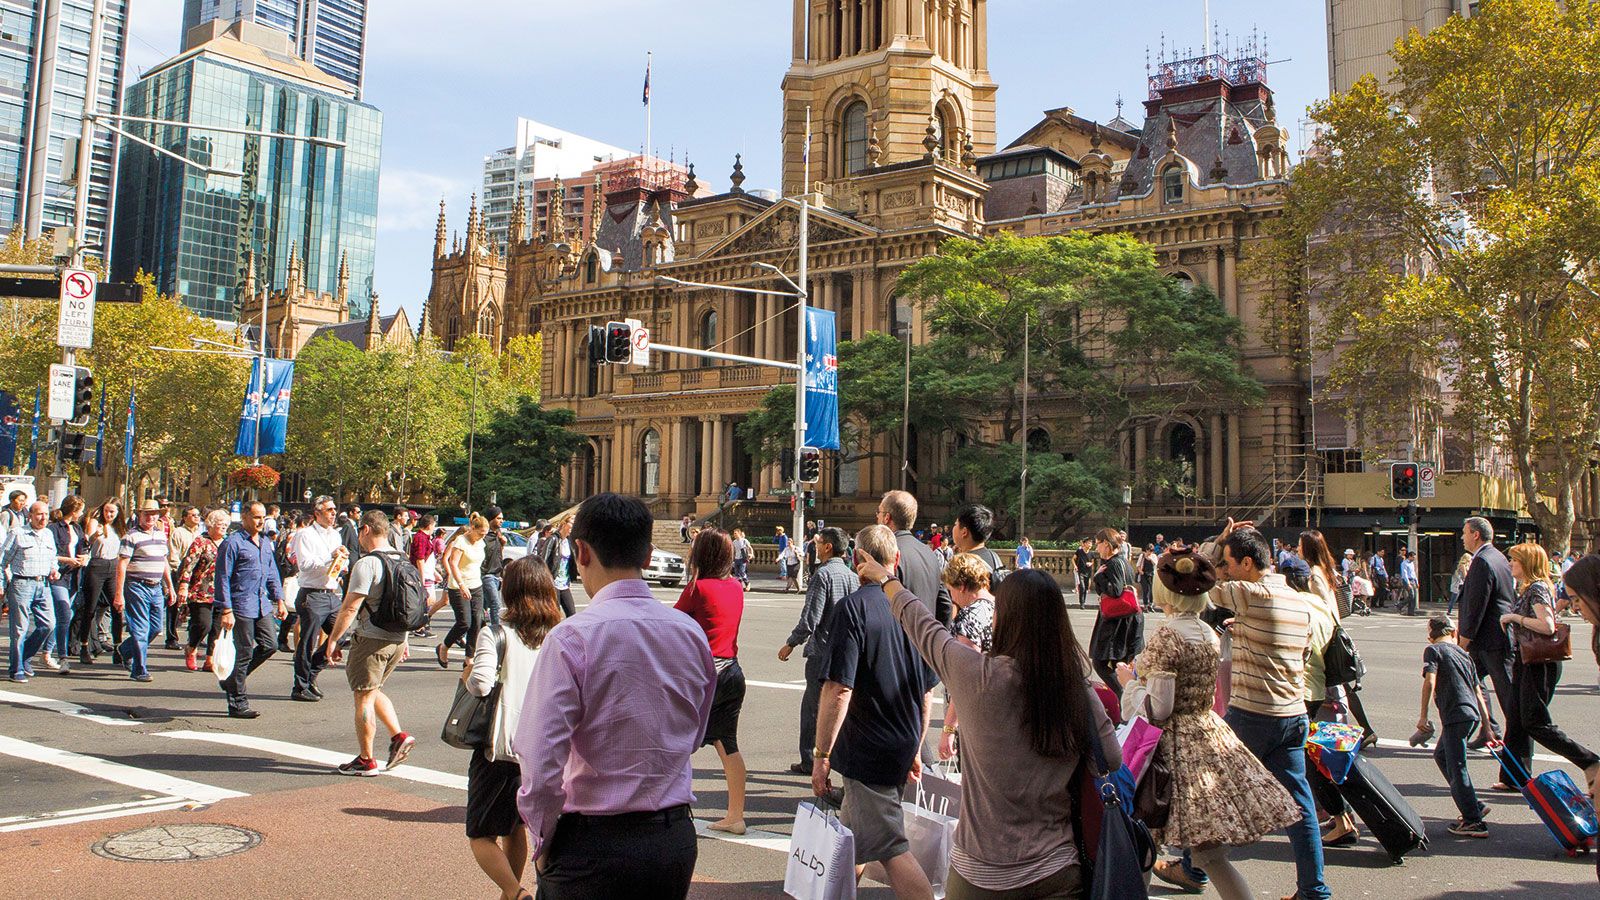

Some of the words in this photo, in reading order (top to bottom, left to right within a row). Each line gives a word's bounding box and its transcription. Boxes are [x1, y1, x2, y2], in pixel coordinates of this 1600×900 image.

[69, 300, 86, 310] NO
[65, 319, 88, 327] TURN
[53, 380, 71, 388] LANE
[792, 847, 825, 877] ALDO
